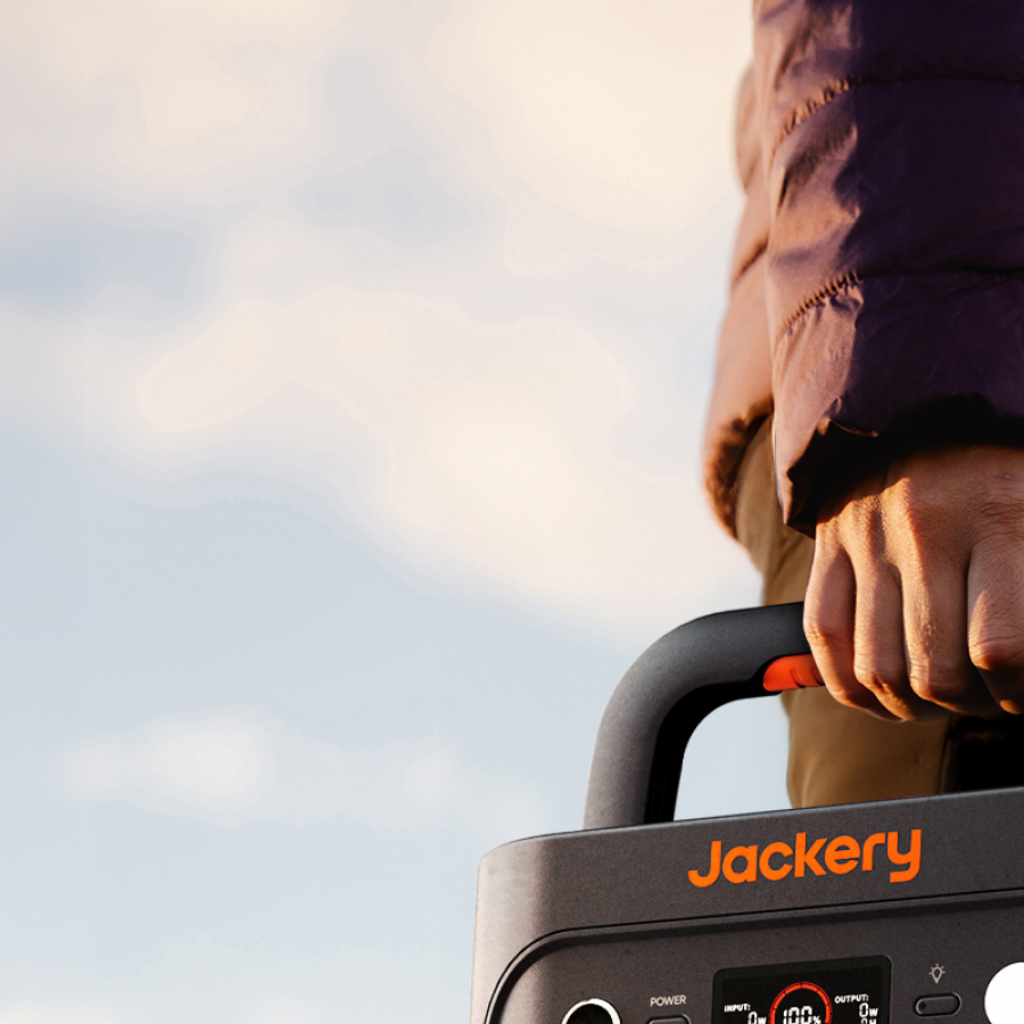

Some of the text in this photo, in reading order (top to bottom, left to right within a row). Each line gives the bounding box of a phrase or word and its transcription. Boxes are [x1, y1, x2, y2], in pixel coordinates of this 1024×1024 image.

[688, 829, 923, 888] Jackery
[650, 994, 687, 1006] POWER
[834, 994, 869, 1004] OUTPUT:
